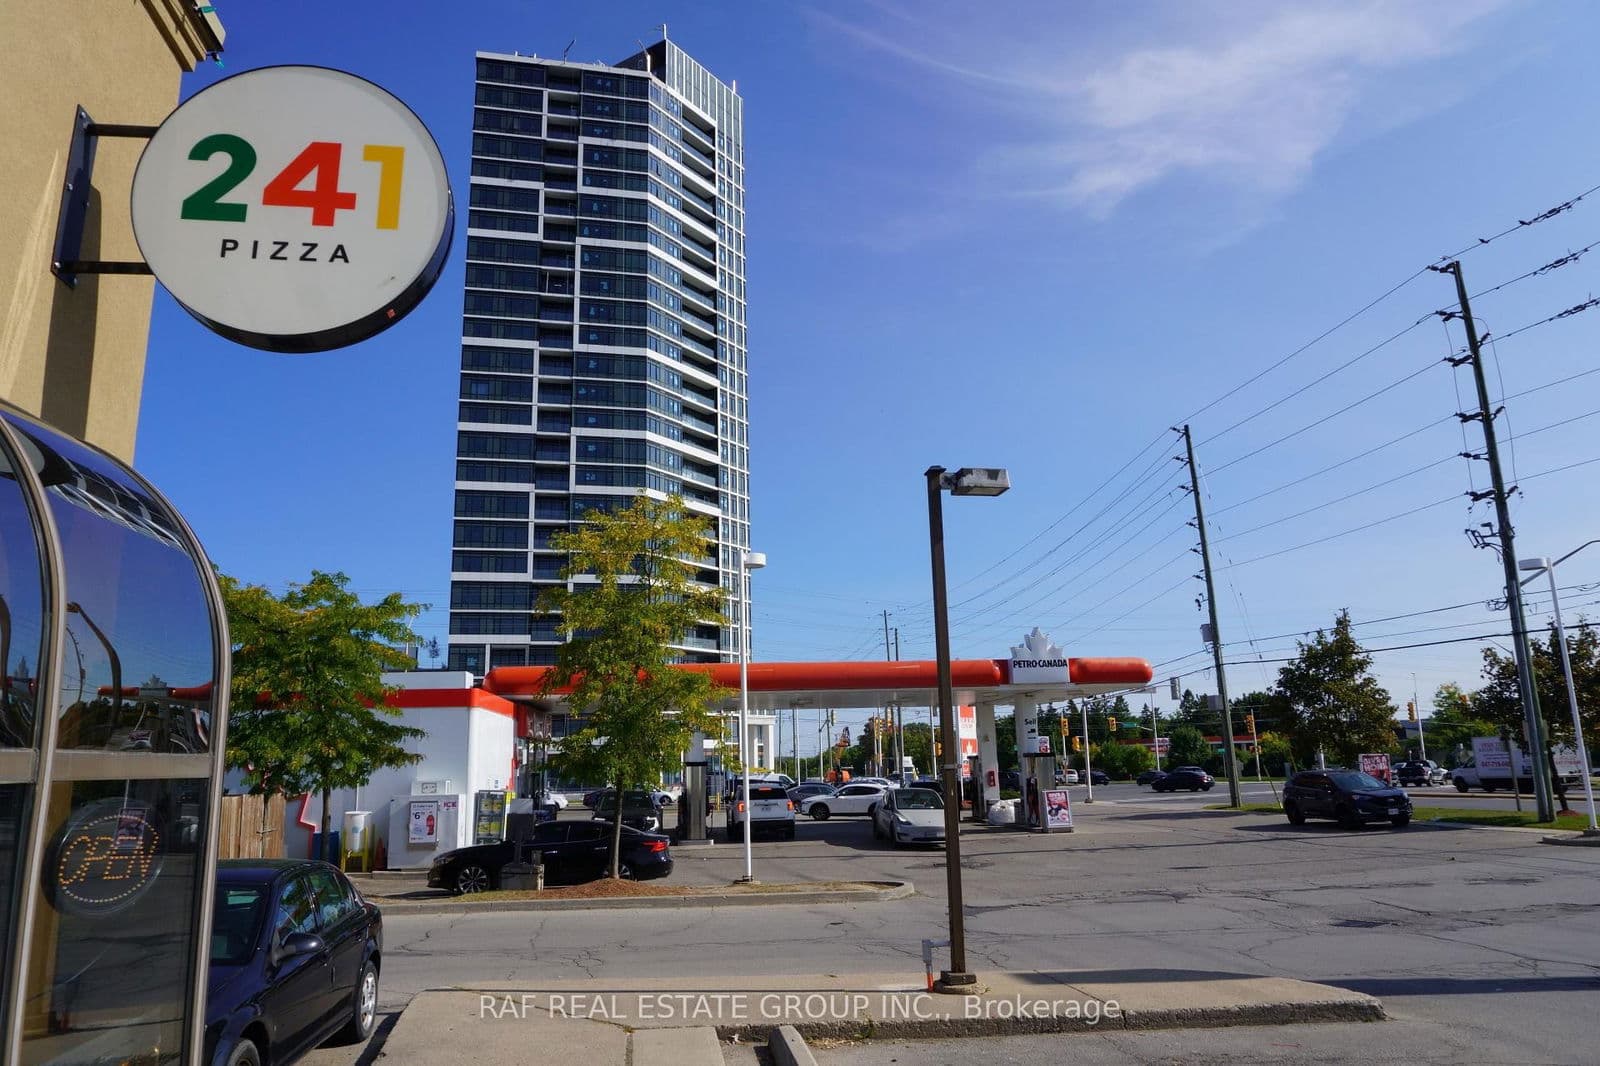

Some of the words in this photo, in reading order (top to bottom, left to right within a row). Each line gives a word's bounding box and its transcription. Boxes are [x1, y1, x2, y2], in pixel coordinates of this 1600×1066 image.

[181, 134, 405, 230] 241
[220, 239, 350, 263] PIZZA
[59, 836, 157, 884] OPEN
